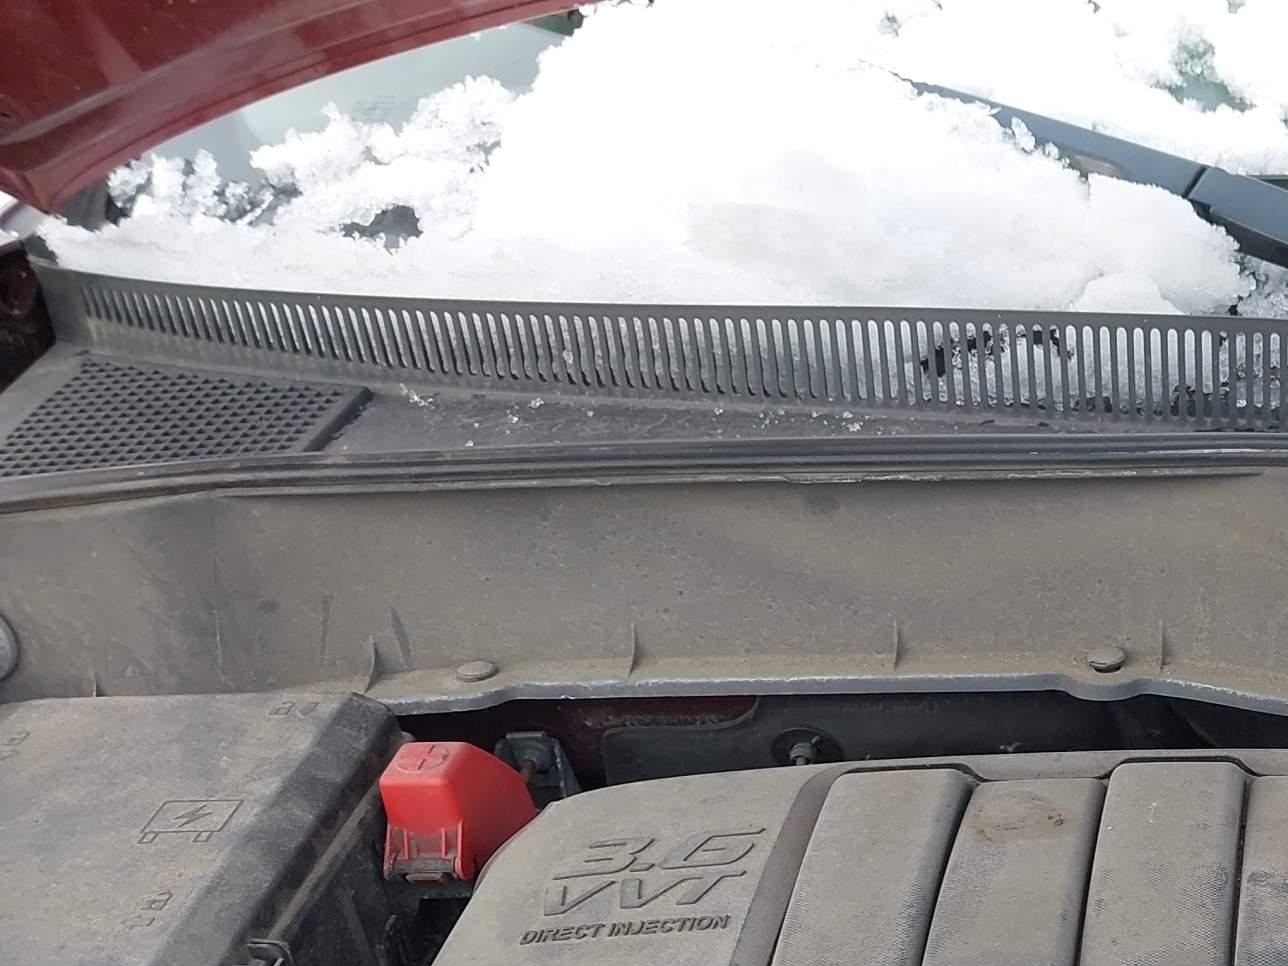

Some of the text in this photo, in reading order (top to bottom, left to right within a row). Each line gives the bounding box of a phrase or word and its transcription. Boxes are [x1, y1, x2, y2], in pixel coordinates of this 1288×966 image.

[552, 827, 766, 881] 3.6
[543, 870, 747, 917] VVT
[519, 914, 731, 946] DIRECT INJECTION
